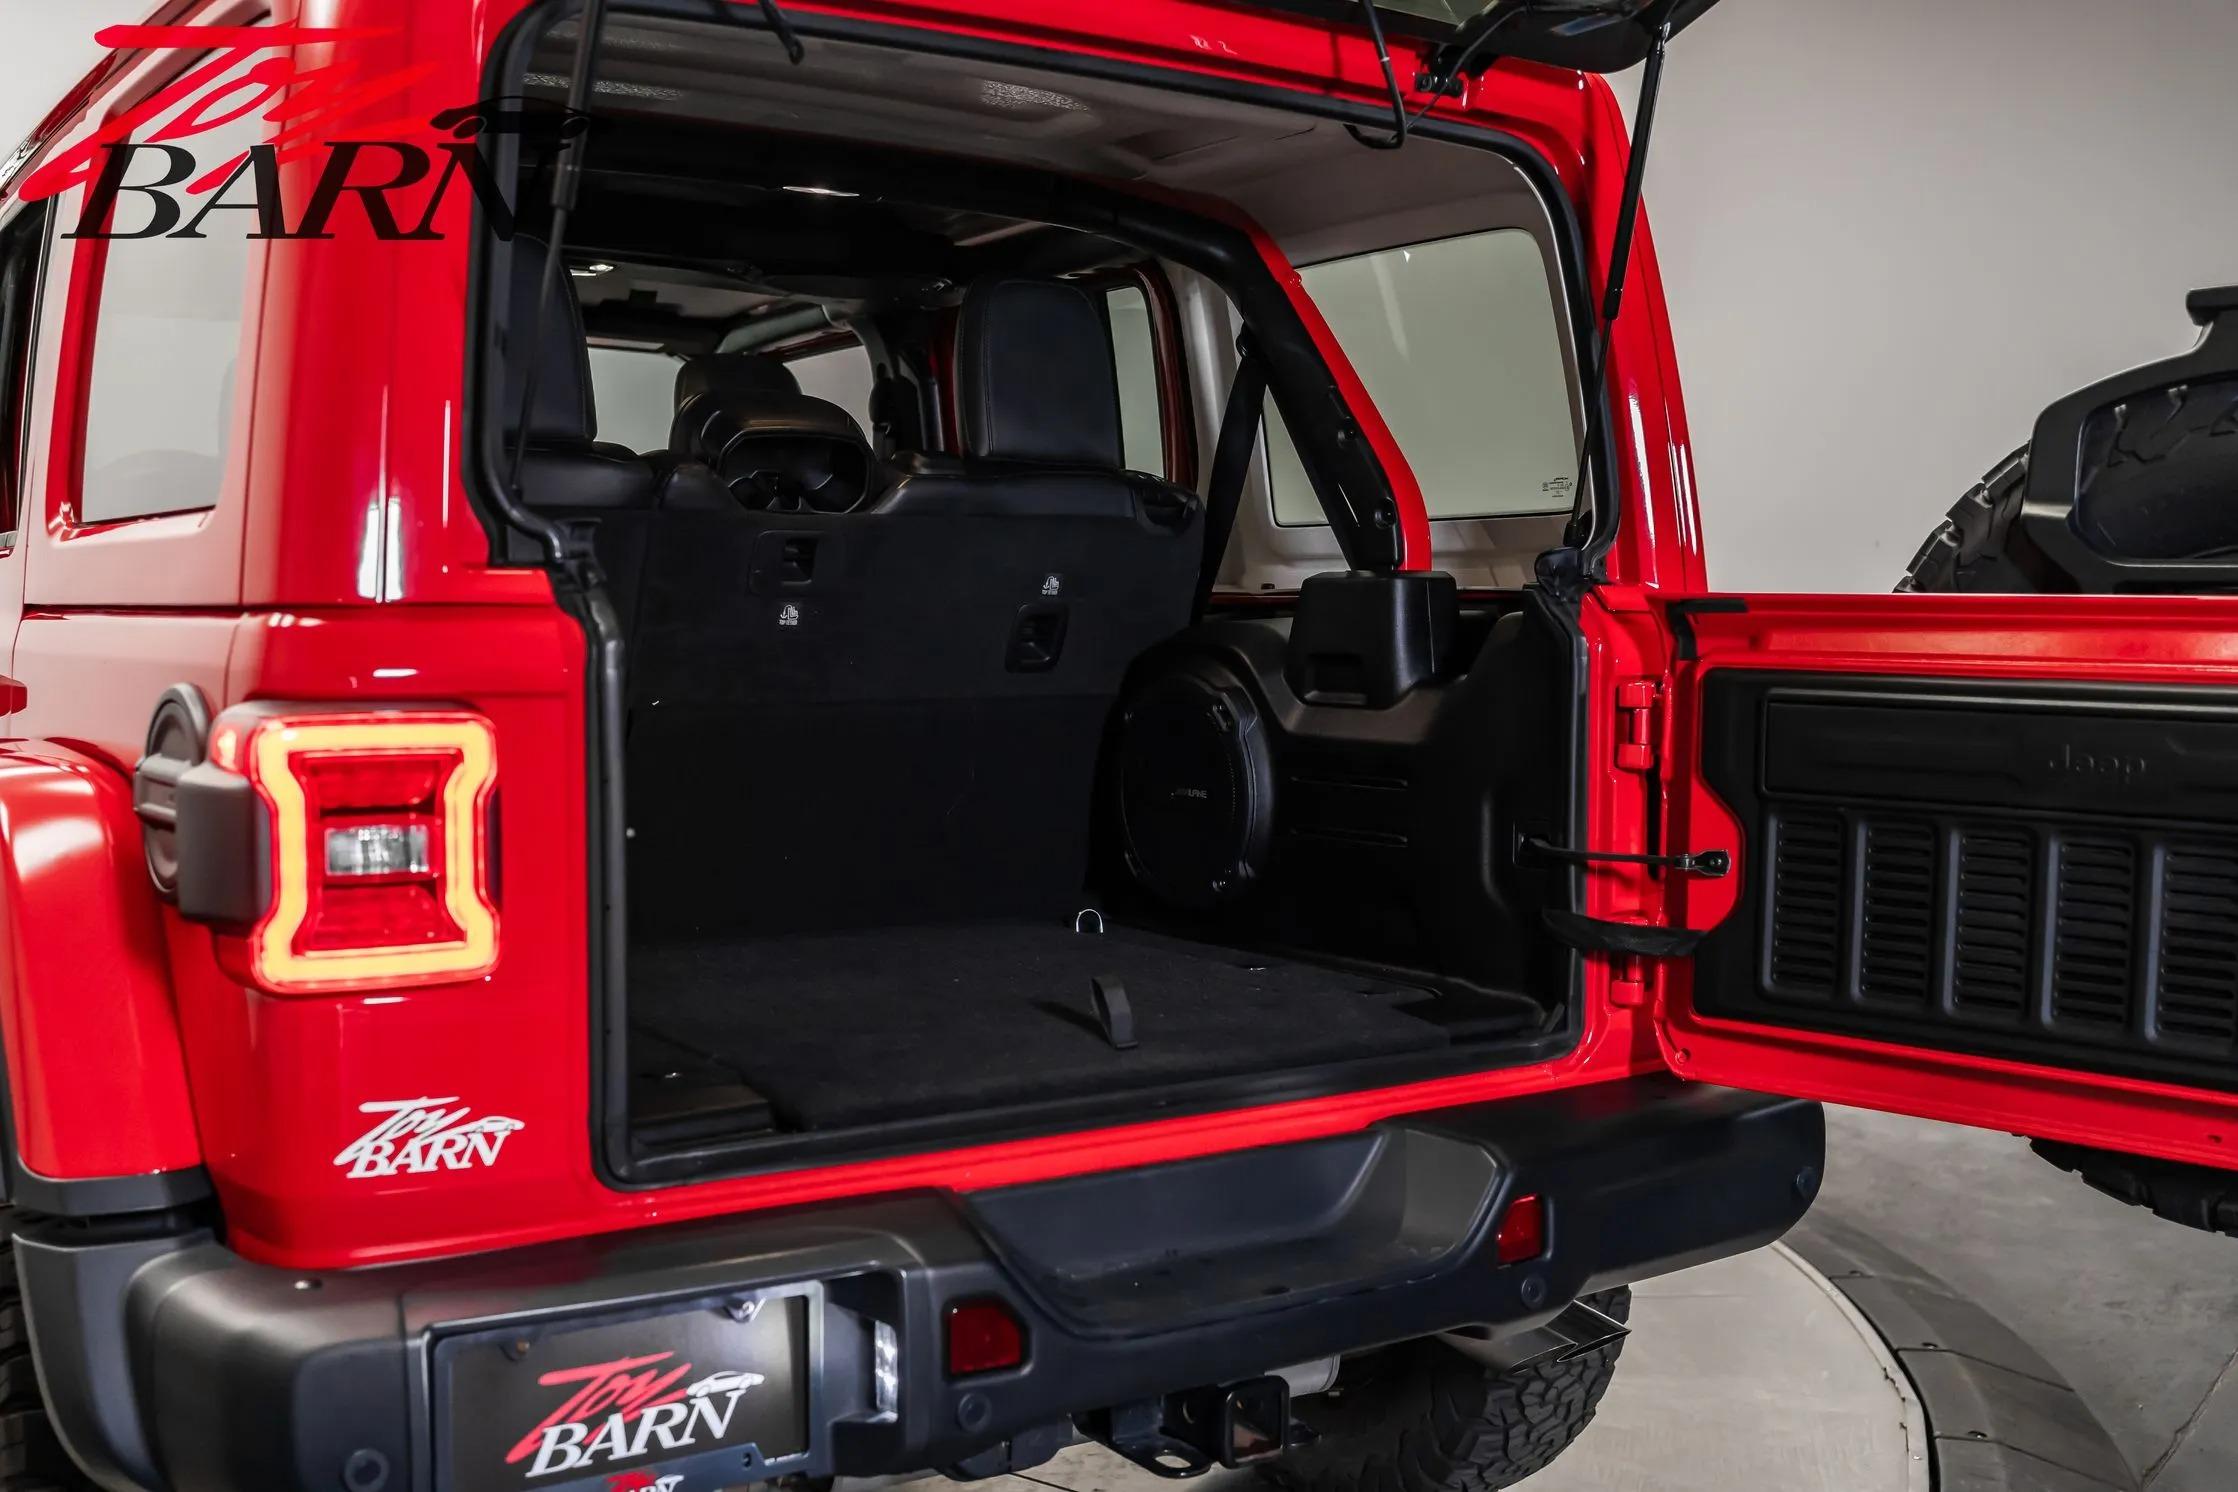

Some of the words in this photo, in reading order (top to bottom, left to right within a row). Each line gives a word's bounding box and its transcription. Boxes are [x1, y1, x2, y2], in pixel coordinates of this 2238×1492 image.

[346, 1131, 511, 1178] BARN
[505, 1351, 692, 1464] Toy
[525, 1390, 746, 1478] BARN
